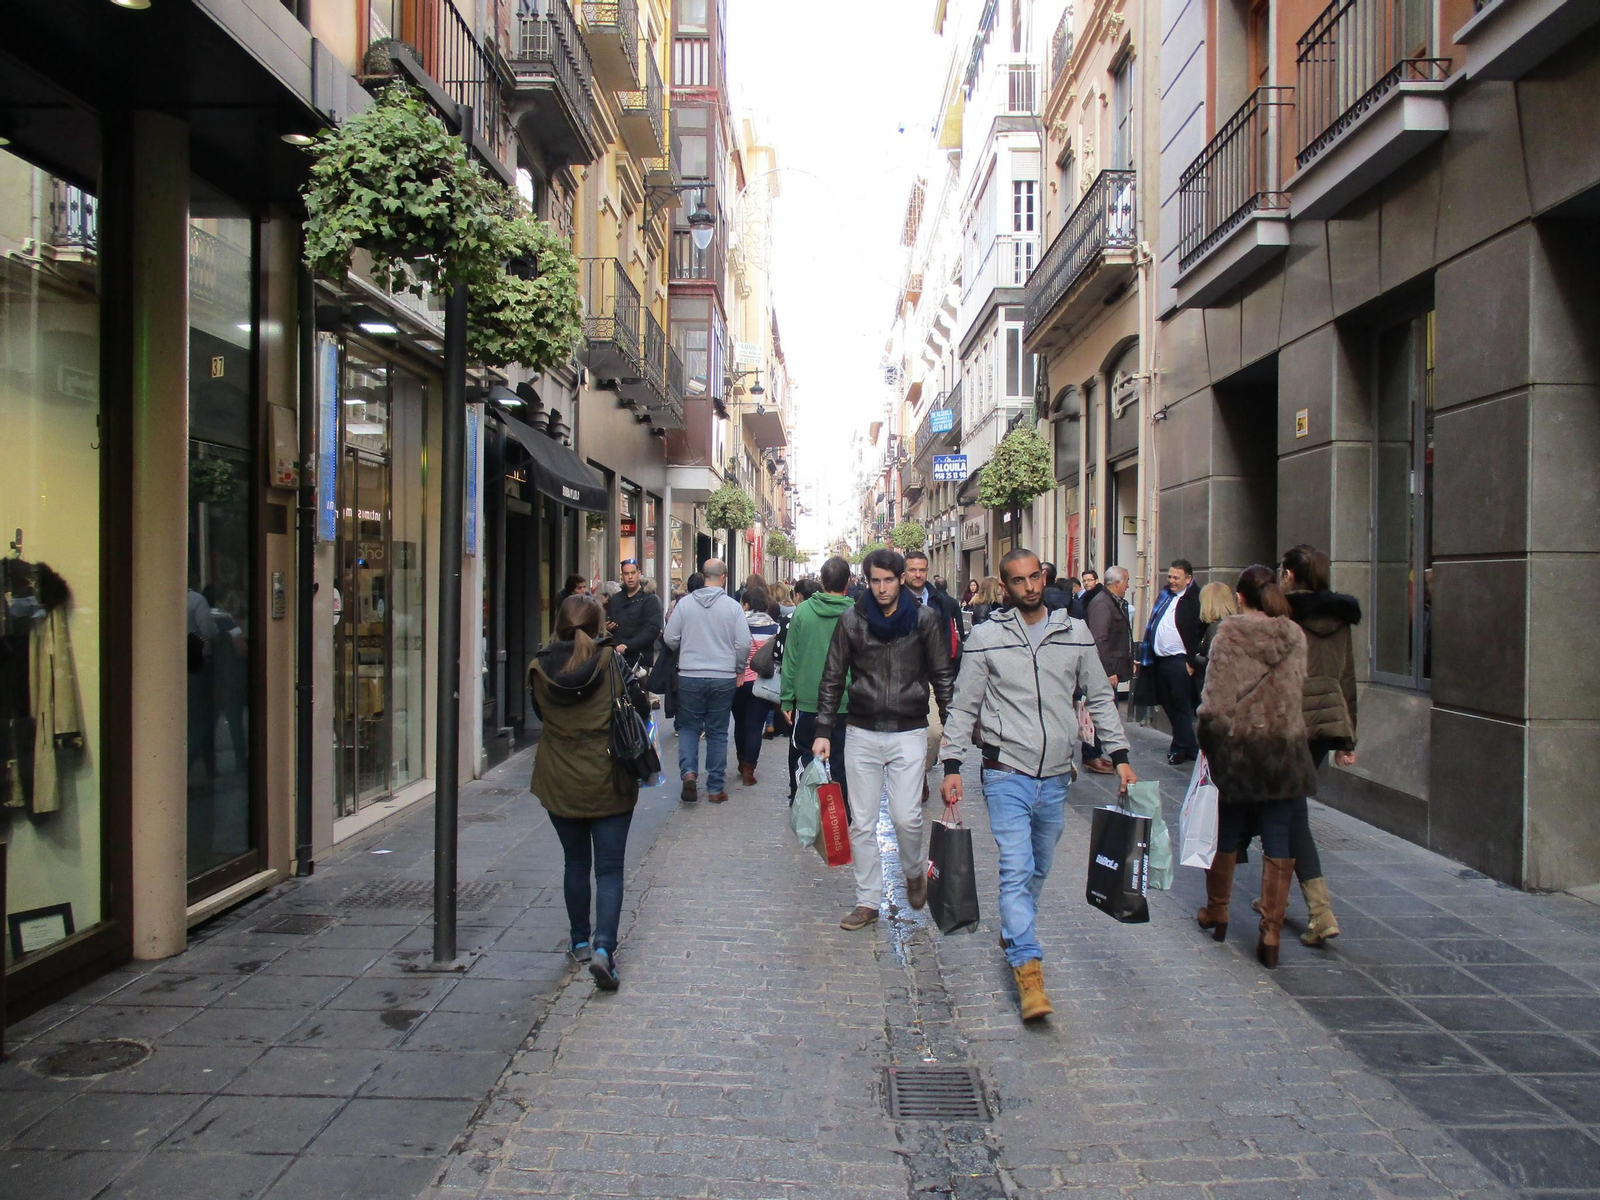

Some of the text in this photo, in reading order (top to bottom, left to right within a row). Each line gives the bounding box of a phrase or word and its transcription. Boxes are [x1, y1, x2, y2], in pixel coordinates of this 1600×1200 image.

[739, 343, 762, 351] LQUIA
[213, 358, 223, 376] 37
[934, 463, 966, 472] ALQUILA
[827, 794, 842, 851] SPRINGFIELD
